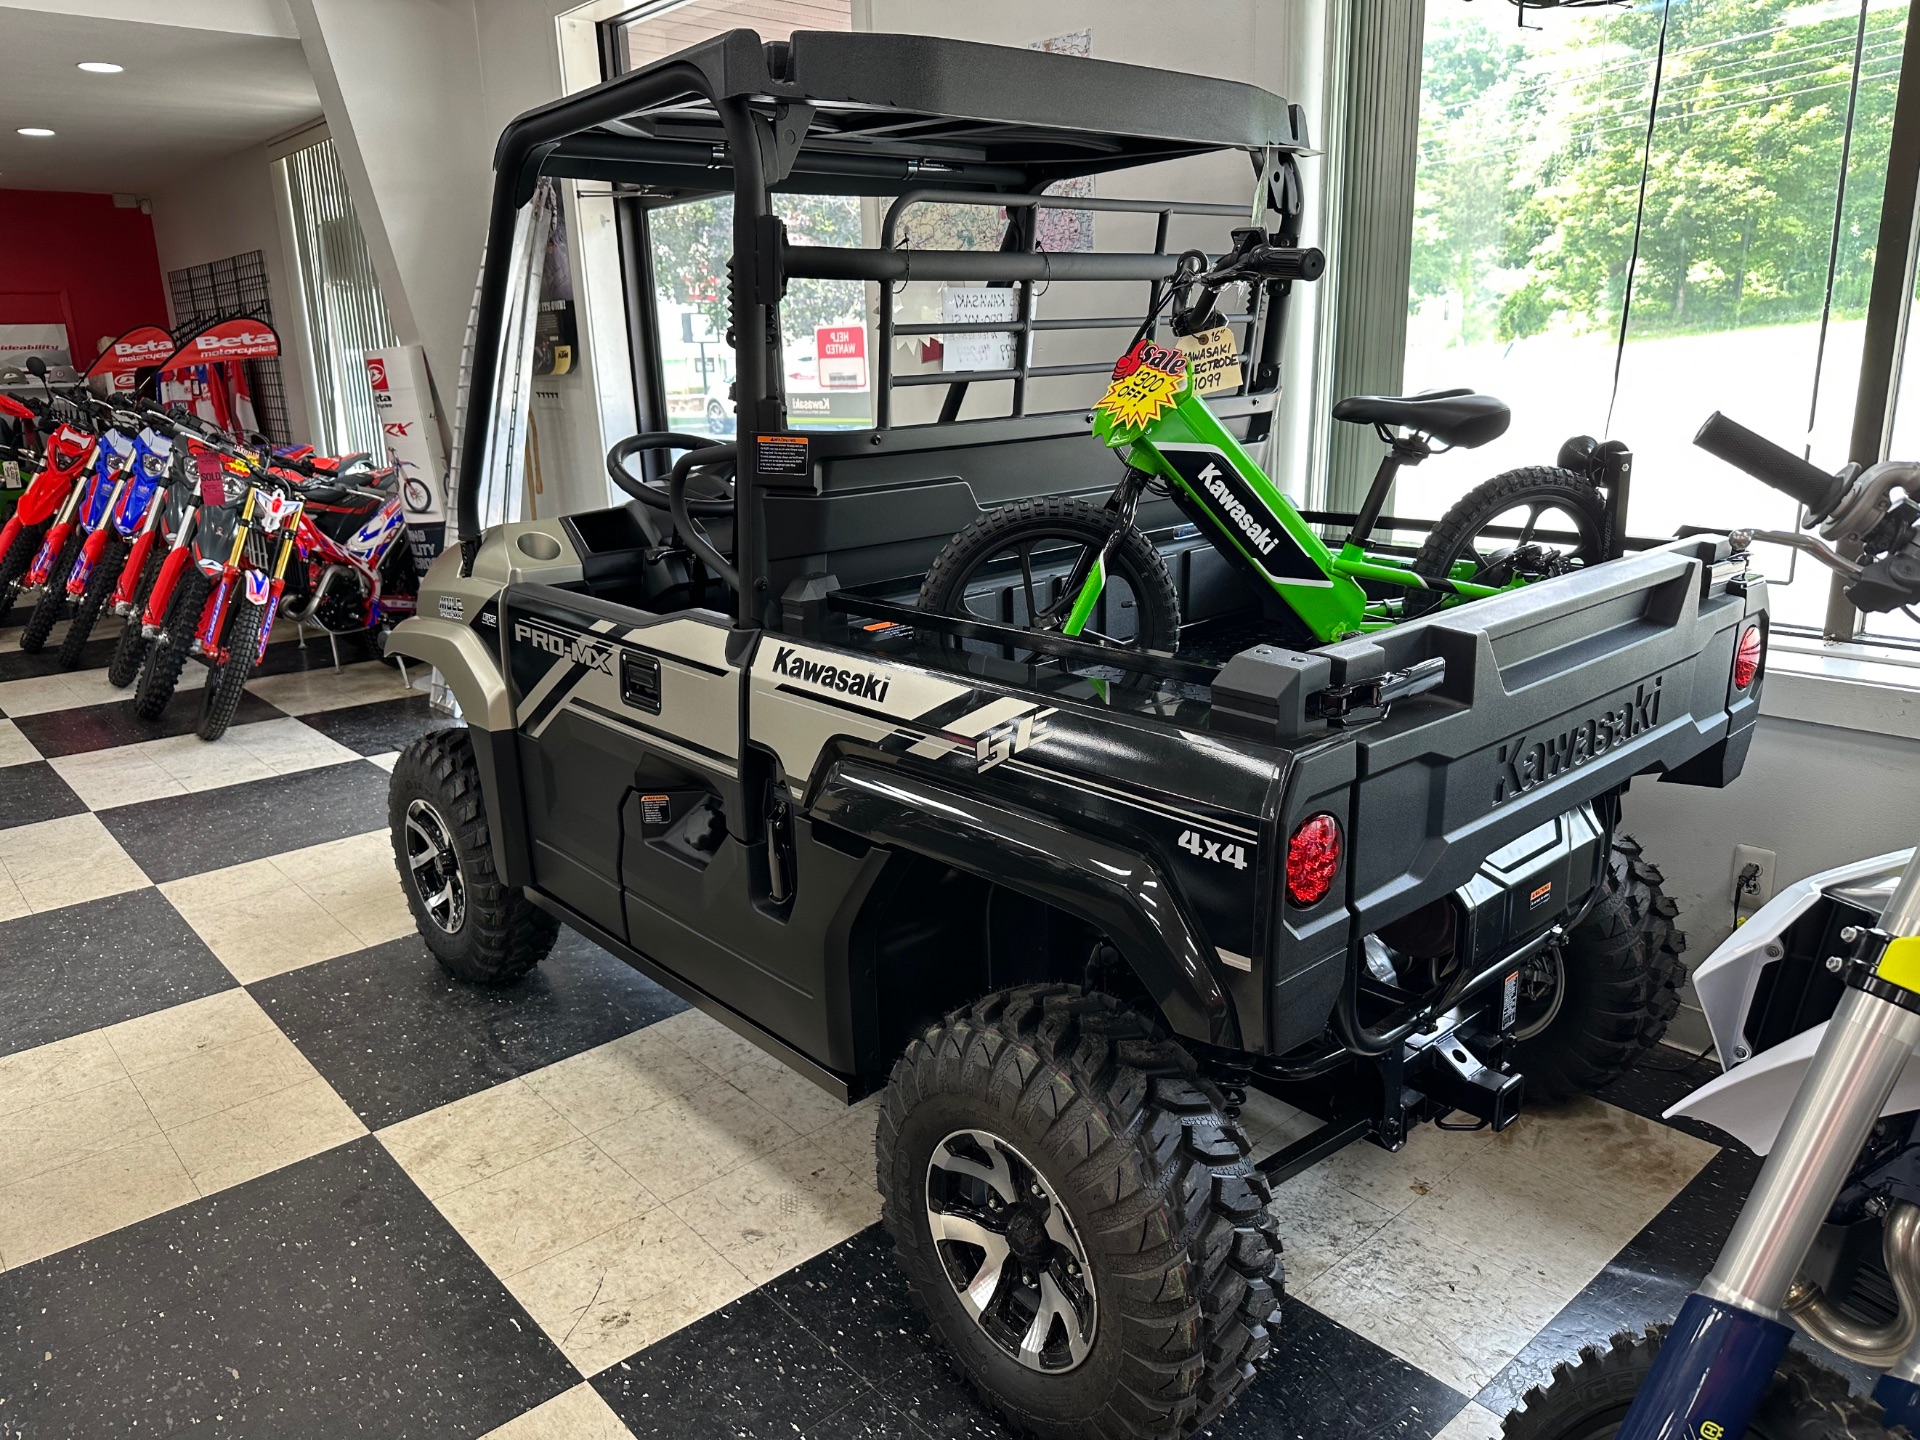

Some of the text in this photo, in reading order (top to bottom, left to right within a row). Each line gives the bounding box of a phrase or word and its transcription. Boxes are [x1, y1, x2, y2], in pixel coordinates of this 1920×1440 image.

[114, 339, 174, 356] Beta
[195, 332, 275, 350] Beta
[200, 344, 277, 359] motorcycles
[1188, 354, 1239, 375] ECTRODE
[1133, 369, 1165, 392] $300
[1194, 372, 1222, 391] 1099
[1117, 385, 1148, 407] OFF!
[200, 471, 221, 482] SOLD
[1197, 462, 1280, 556] Kawasaki
[514, 622, 613, 677] PRO-MX
[771, 646, 892, 703] Kawasaki
[1491, 675, 1663, 807] Kawasaki
[1177, 829, 1248, 871] 4x4
